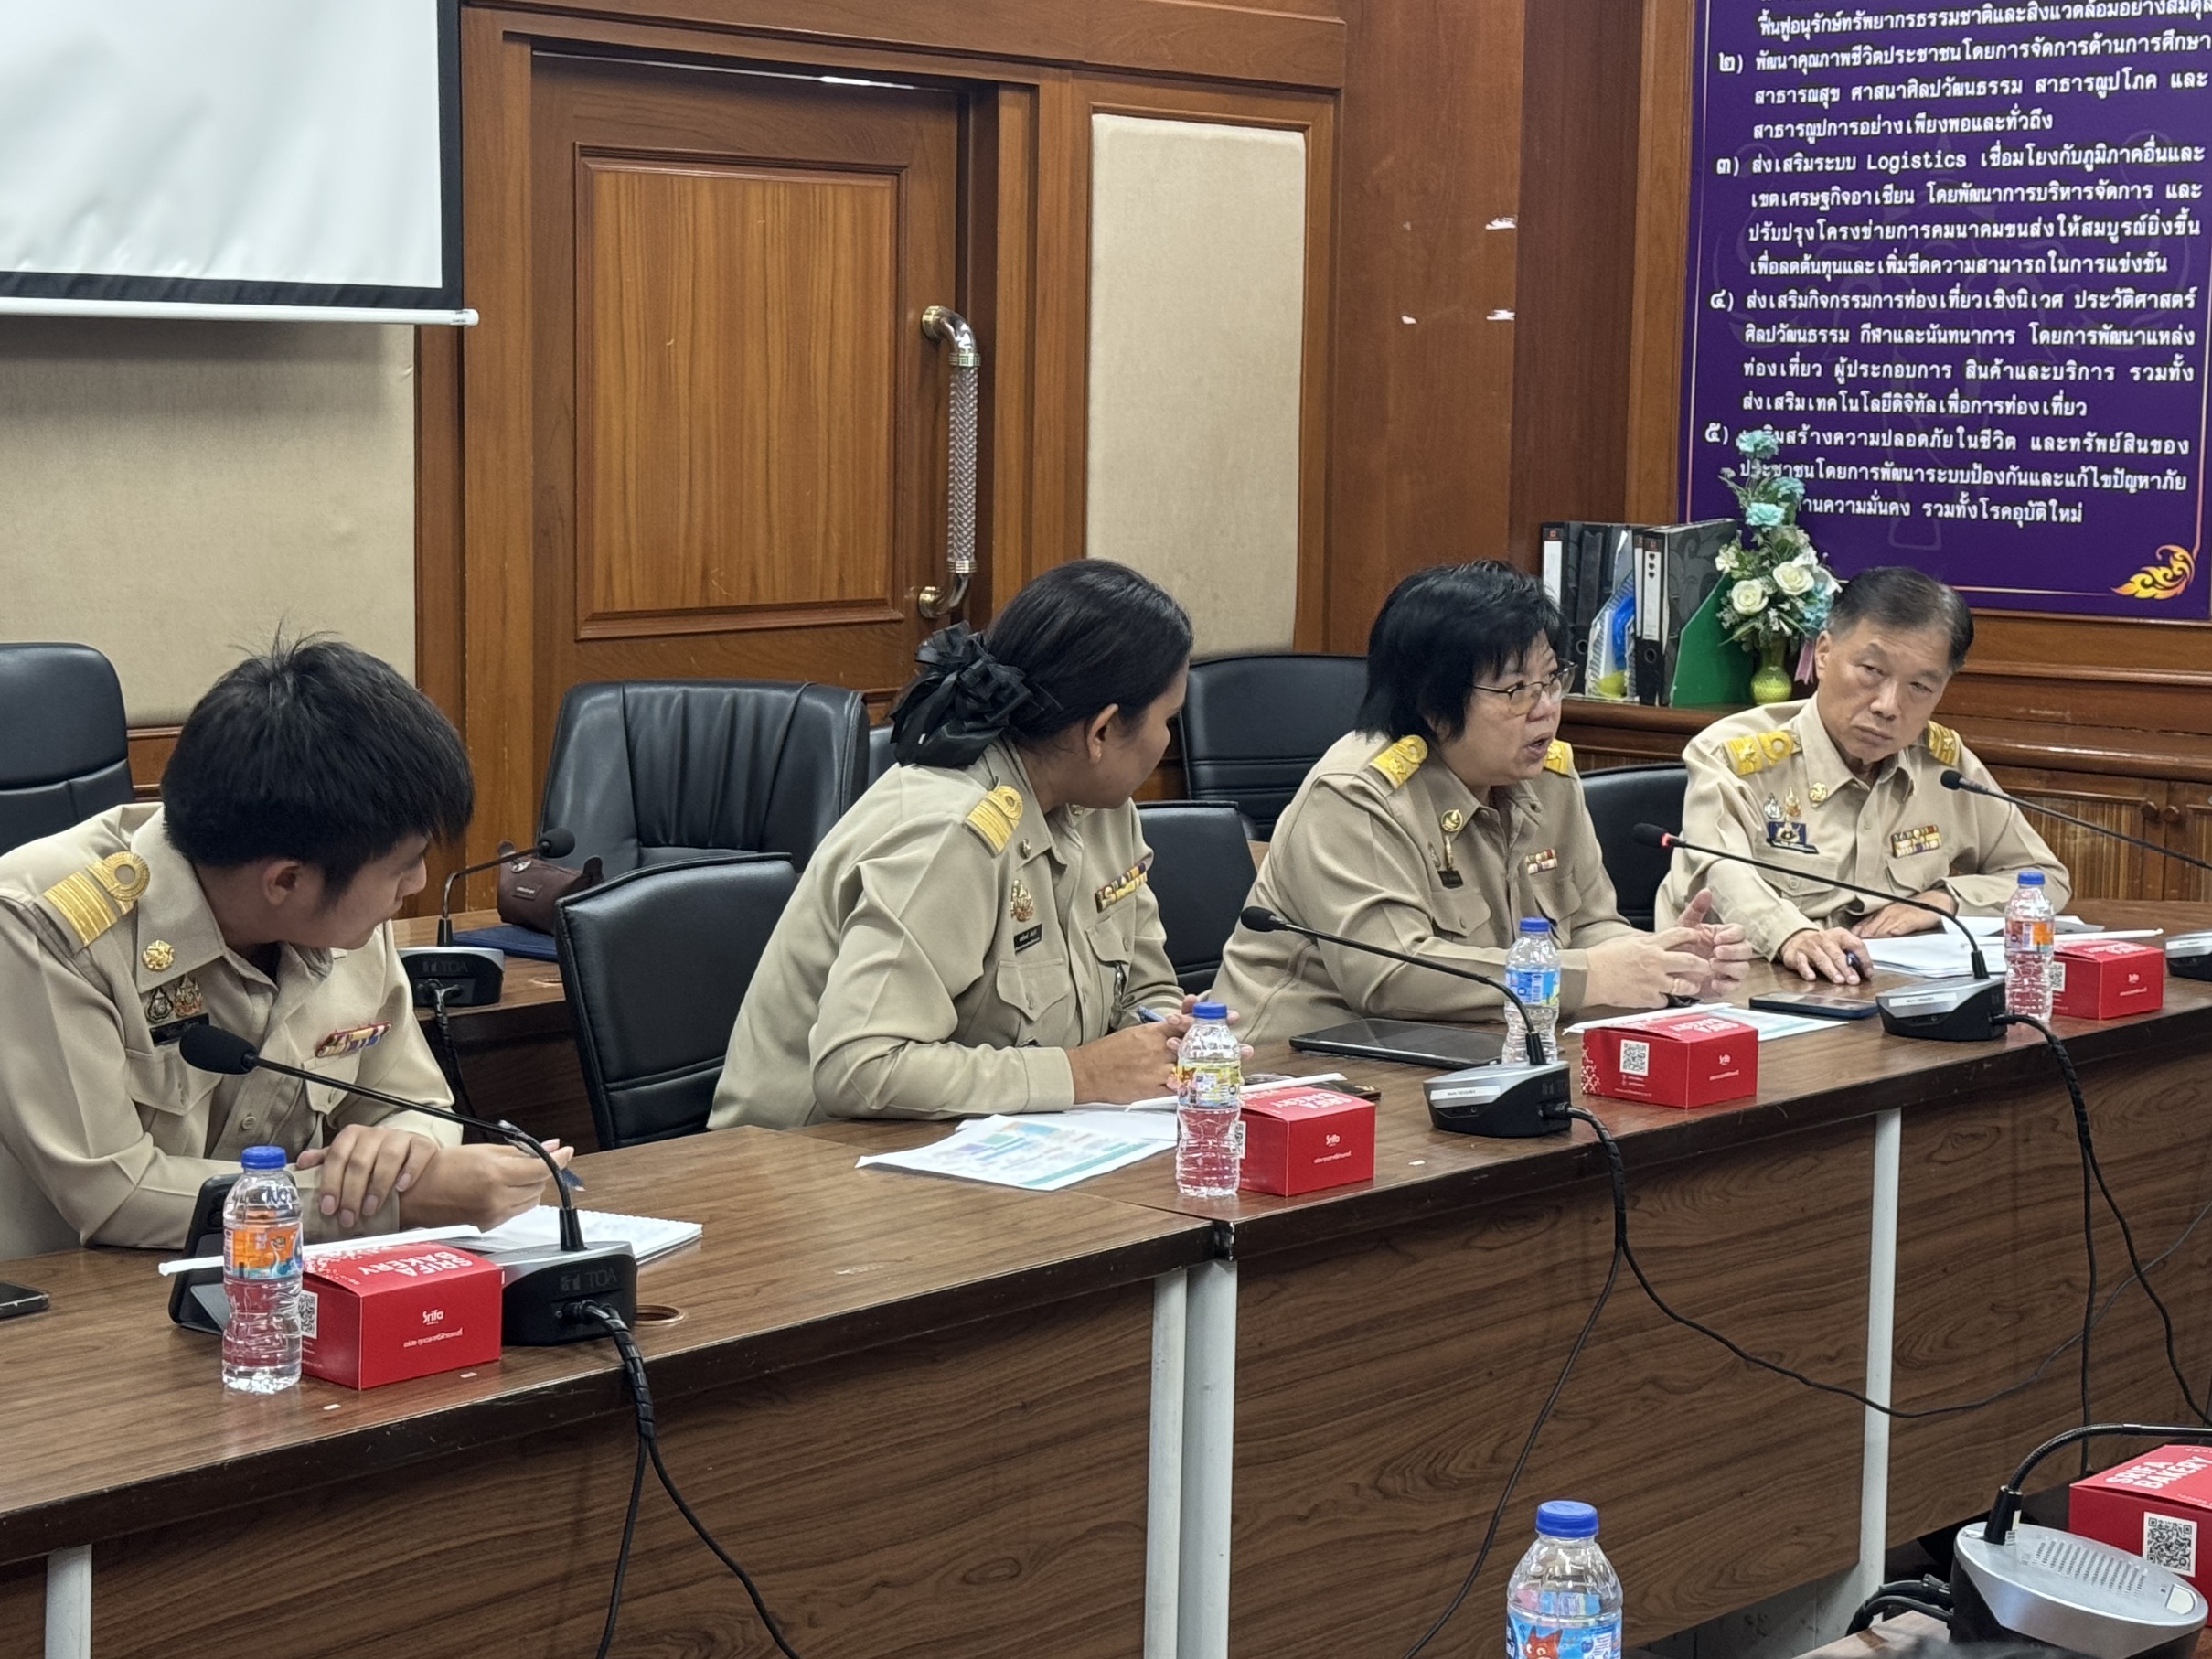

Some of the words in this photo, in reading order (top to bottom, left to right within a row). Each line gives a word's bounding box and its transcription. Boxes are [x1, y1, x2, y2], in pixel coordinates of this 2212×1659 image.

[1718, 52, 1743, 74] ๒)
[1755, 28, 2212, 76] พัฒนาคุณภาพชีวิตประชาชนโดยการจัดการด้านการศึกษา
[1755, 87, 1841, 110] สาธารณสุข
[1851, 75, 2023, 101] ศาสนาศิลปวัฒนธรรม
[2035, 66, 2158, 99] สาธารณูปโภค
[2170, 71, 2208, 89] และ
[1753, 102, 2053, 144] สาธารณูปการอย่างเพียงพอและทั่วถึง
[1716, 156, 1740, 177] ๓)
[1752, 151, 1857, 174] ส่งเสริมระบบ
[1866, 149, 1967, 175] Logistics
[1981, 134, 2206, 173] เชื่อมโยงกับภูมิภาคอื่นและ
[1926, 178, 2154, 204] โดยพัฒนาการบริหารจัดการ
[2165, 183, 2203, 199] และ
[1748, 206, 2201, 248] ปรับปรุงโครงข่ายการคมนาคมขนส่งให้สมบูรณ์ยิ่งขึ้น
[1710, 289, 1734, 312] ๔)
[1747, 282, 2064, 309] ส่งเสริมกิจกรรมการท่องเที่ยวเชิงนิเวศ
[2074, 286, 2198, 309] ประวัติศาสตร์
[1745, 322, 1850, 344] ศิลปวัฒนธรรม
[1860, 322, 2016, 345] กีฬาและนันทนาการ
[2028, 321, 2196, 346] โดยการพัฒนาแหล่ง
[1743, 351, 1822, 378] ท่องเที่ยว
[1834, 356, 1952, 385] ผู้ประกอบการ
[1965, 357, 2115, 381] สินค้าและบริการ
[2129, 353, 2195, 382] รวมทั้ง
[1743, 387, 2088, 416] ส่งเสริมเทคโนโลยีดิจิทัลเพื่อการท่องเที่ยว
[1704, 422, 1729, 445] ๕)
[1742, 423, 2016, 450] ิมสร้างความปลอดภัยในชีวิต
[2030, 431, 2189, 455] และทรัพย์สินของ
[1739, 457, 2187, 494] ปะชาชนโดยการพัฒนาระบบป้องกันและแก้ไขปัญหาภัย
[1797, 489, 1911, 517] านความมั่นคง
[1922, 491, 2083, 528] รวมทั้งโรคอุบัติใหม่
[358, 1250, 459, 1276] BAKERY
[394, 1257, 474, 1278] SRIFA
[585, 1268, 618, 1288] TOA
[422, 1309, 444, 1324] Srifa
[2105, 1461, 2175, 1484] SRIFA
[2132, 1455, 2212, 1490] BAKERY
